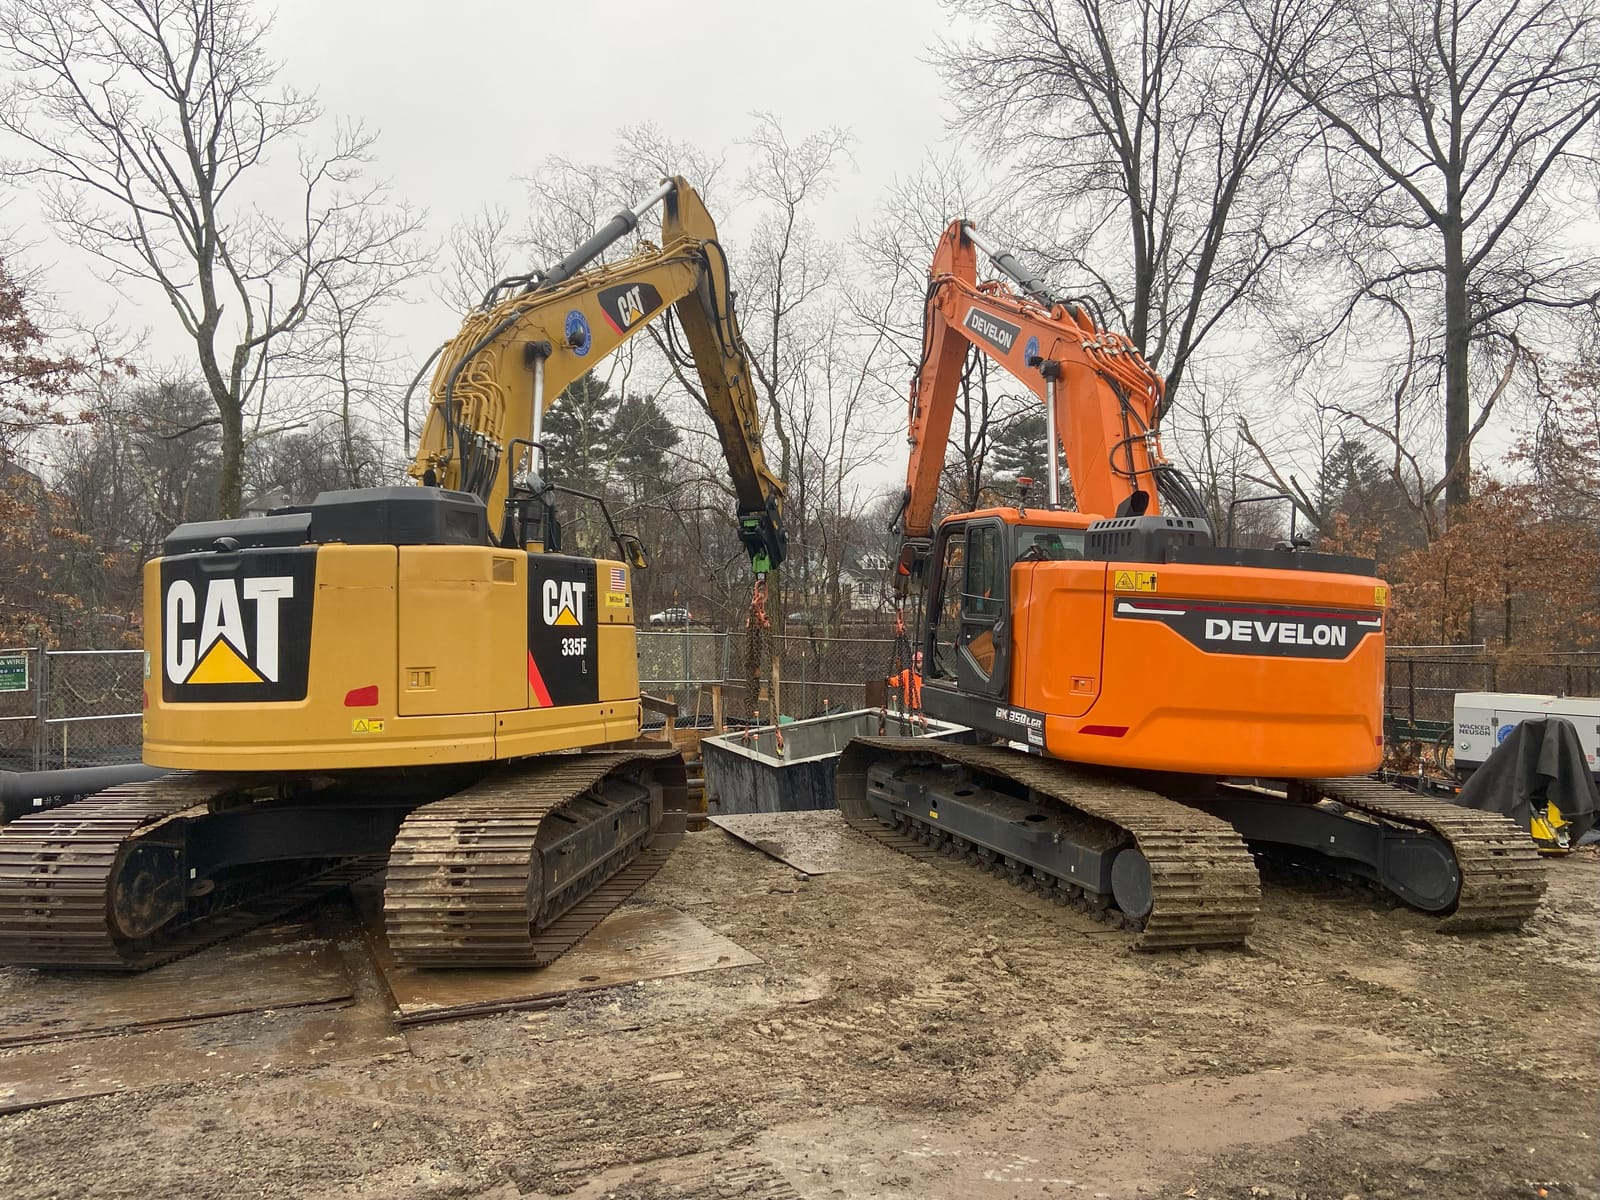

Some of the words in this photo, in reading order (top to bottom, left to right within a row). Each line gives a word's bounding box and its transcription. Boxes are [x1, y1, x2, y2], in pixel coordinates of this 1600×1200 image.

[617, 285, 645, 327] CAT
[971, 314, 1012, 349] DEVELON
[542, 579, 586, 626] CAT
[167, 576, 294, 684] CAT
[1205, 618, 1347, 647] DEVELON
[561, 637, 587, 657] 335F
[581, 660, 587, 674] L
[1458, 723, 1490, 731] WACKER
